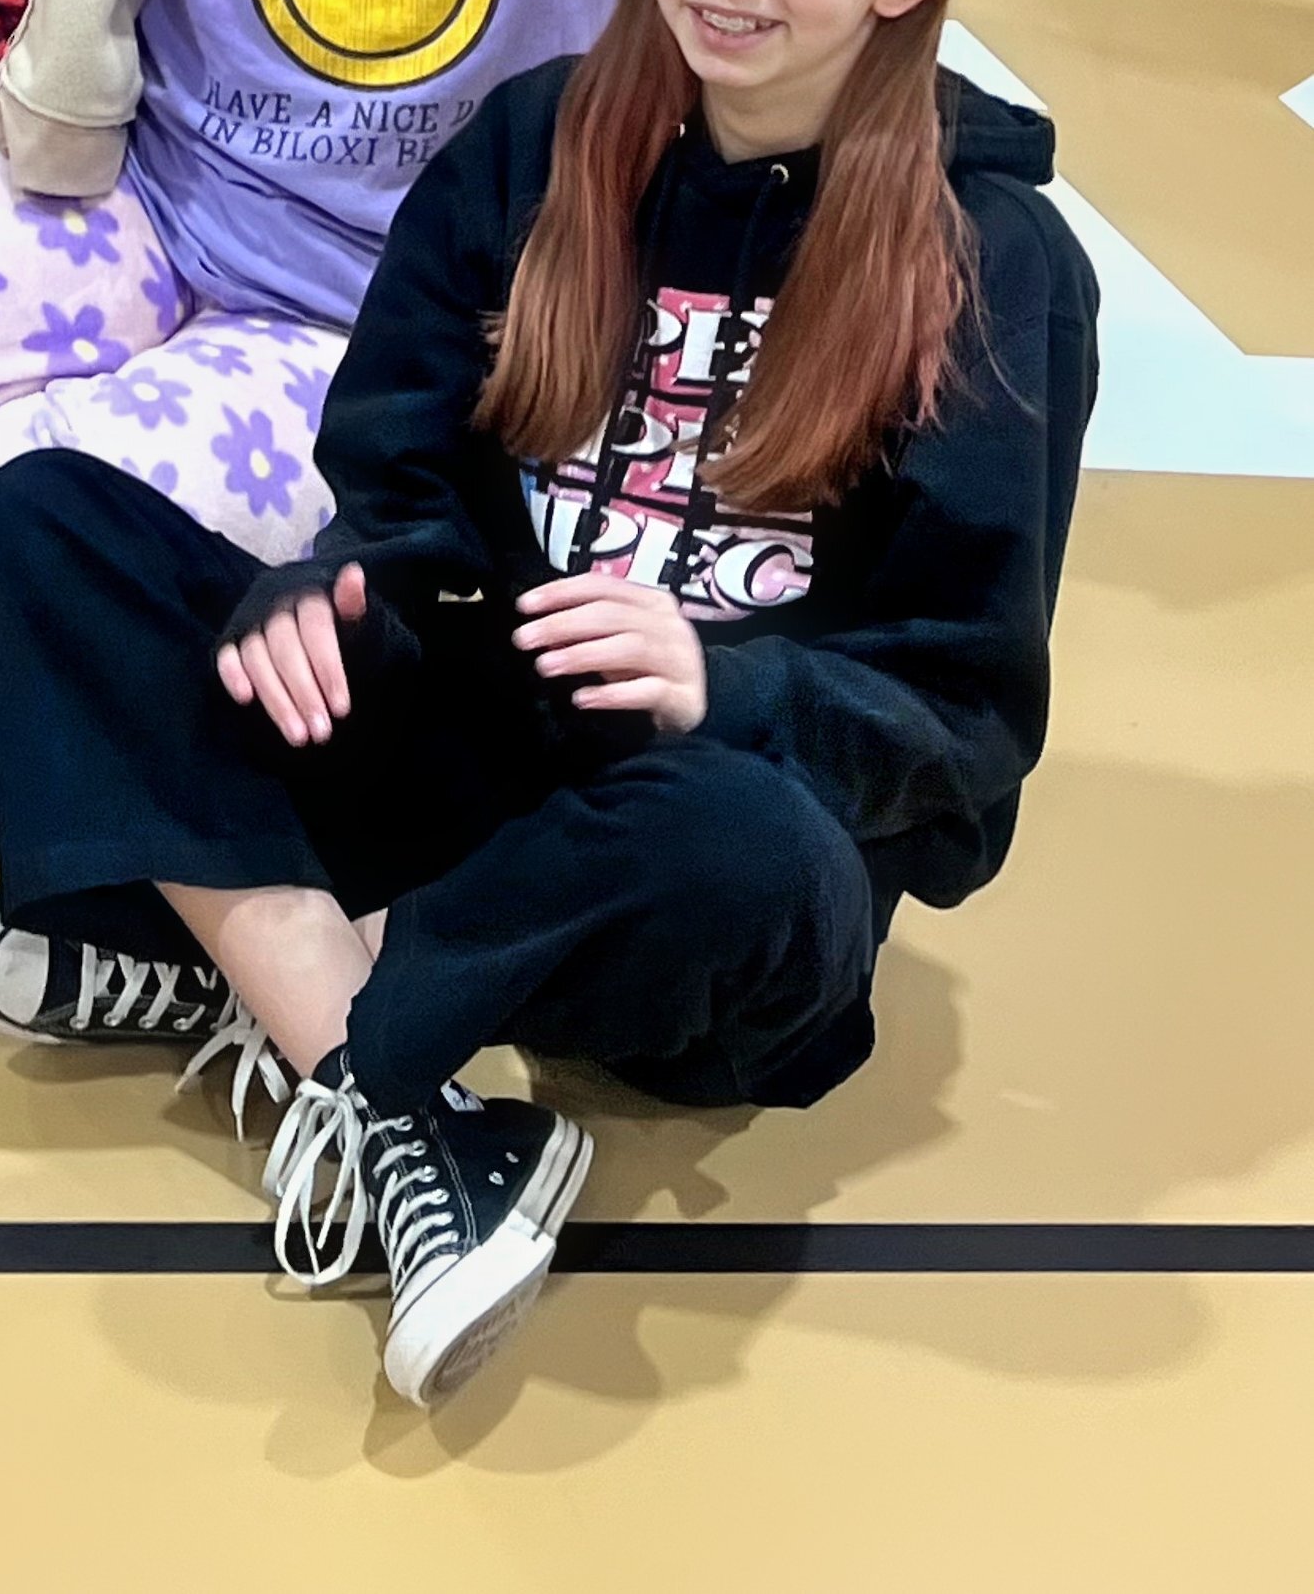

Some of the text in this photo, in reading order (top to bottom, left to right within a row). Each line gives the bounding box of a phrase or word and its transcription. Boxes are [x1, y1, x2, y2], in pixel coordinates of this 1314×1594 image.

[202, 75, 292, 124] HAVE
[306, 101, 332, 127] A
[352, 99, 439, 133] NICE
[198, 109, 242, 144] IN
[249, 126, 377, 167] BILOXI
